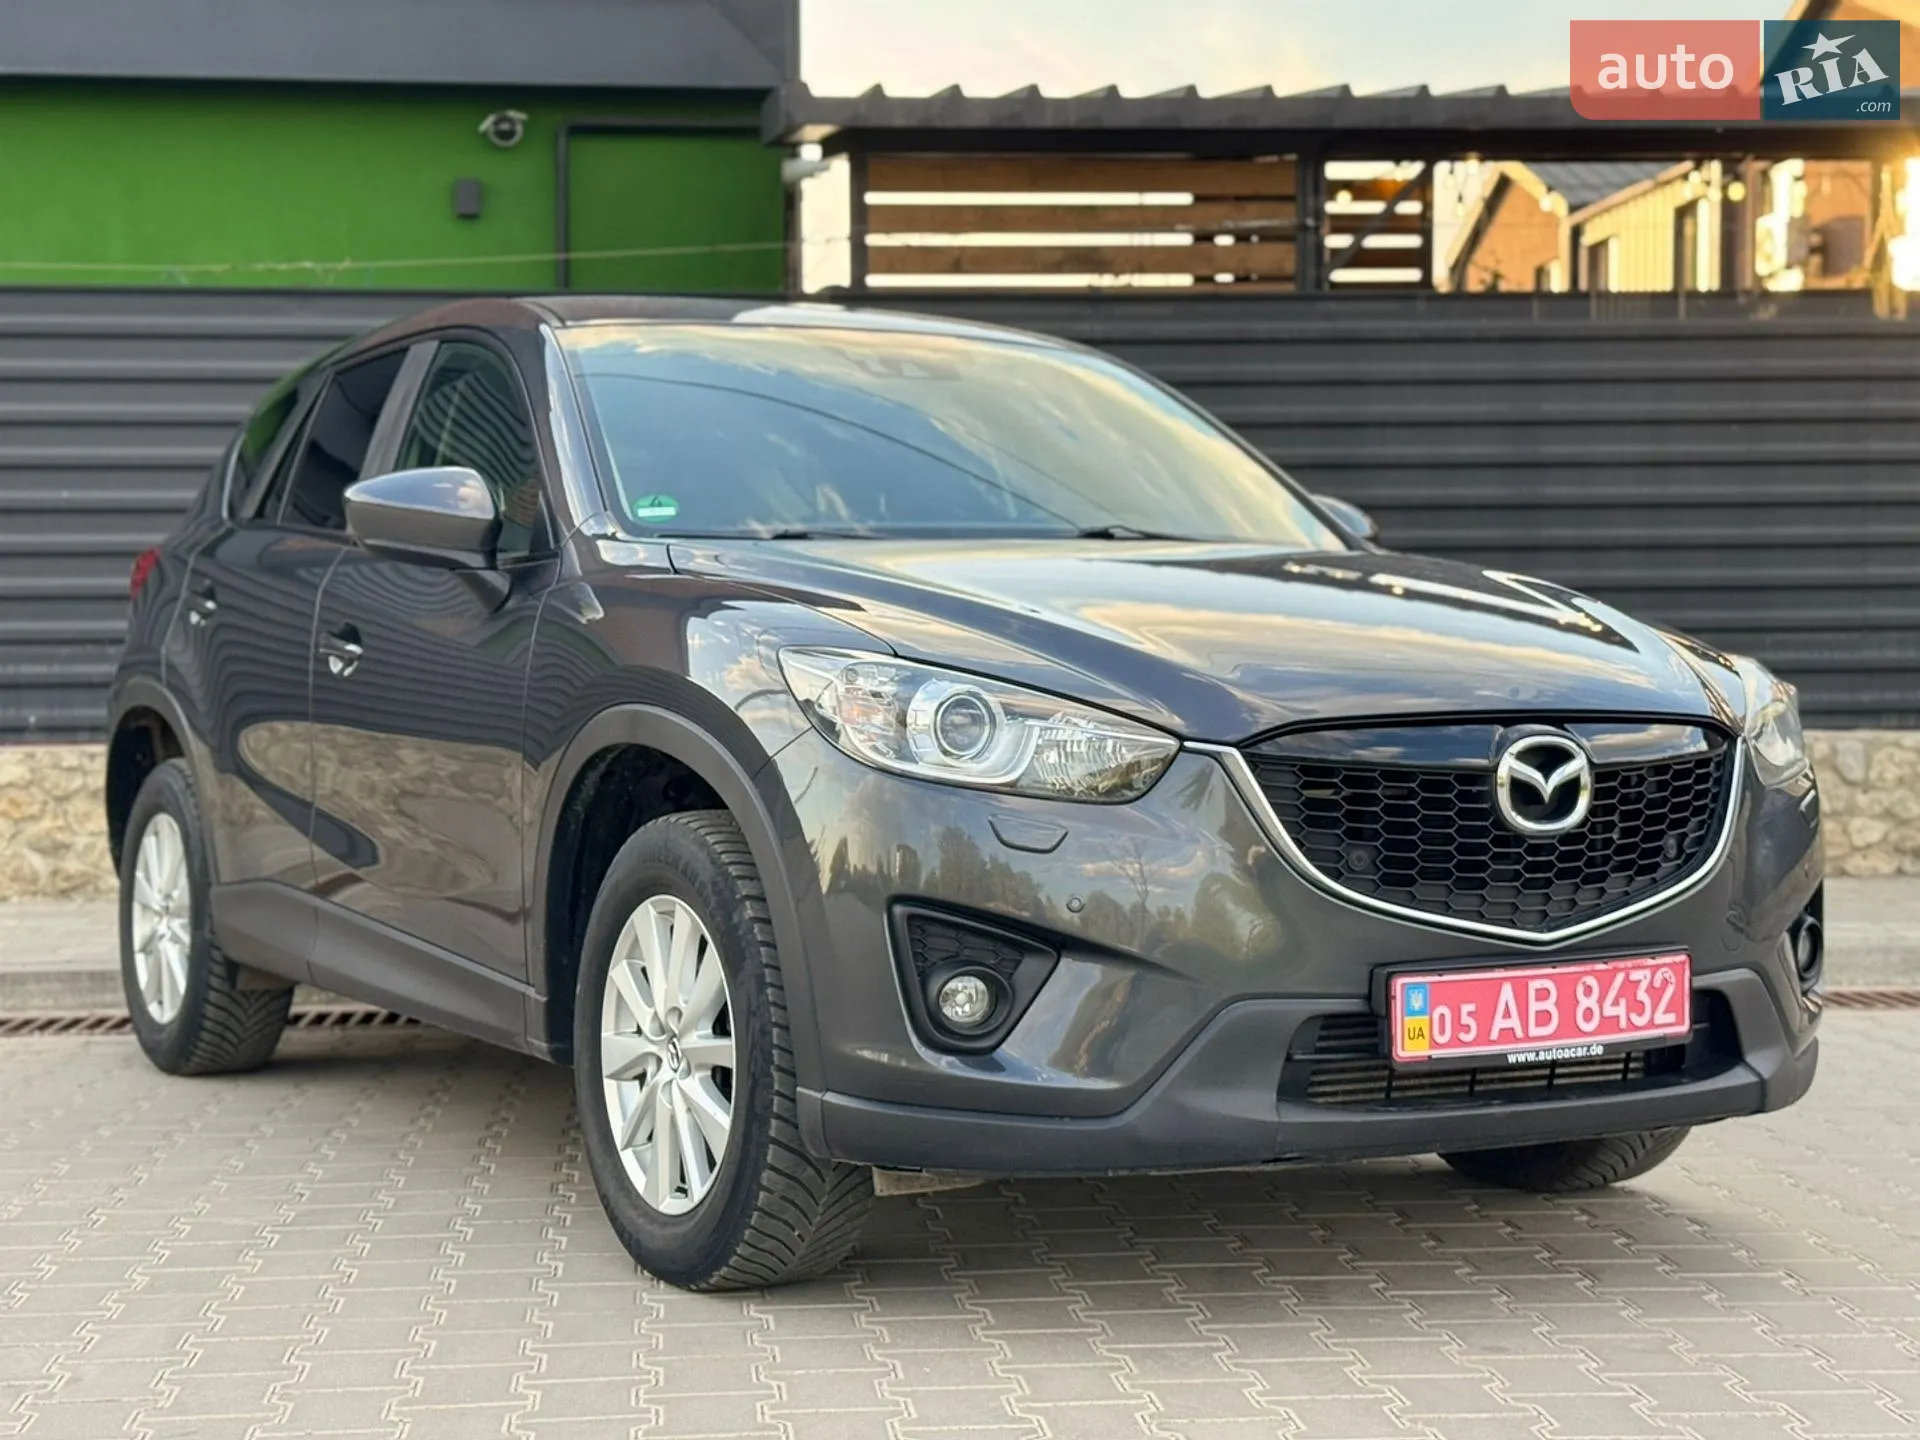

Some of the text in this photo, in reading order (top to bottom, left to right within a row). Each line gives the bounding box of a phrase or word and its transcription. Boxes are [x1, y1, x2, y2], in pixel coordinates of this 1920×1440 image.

[1432, 967, 1676, 1044] 05 AB 8432
[1407, 1026, 1426, 1041] UA
[1507, 1043, 1604, 1064] www.autoacar.de
